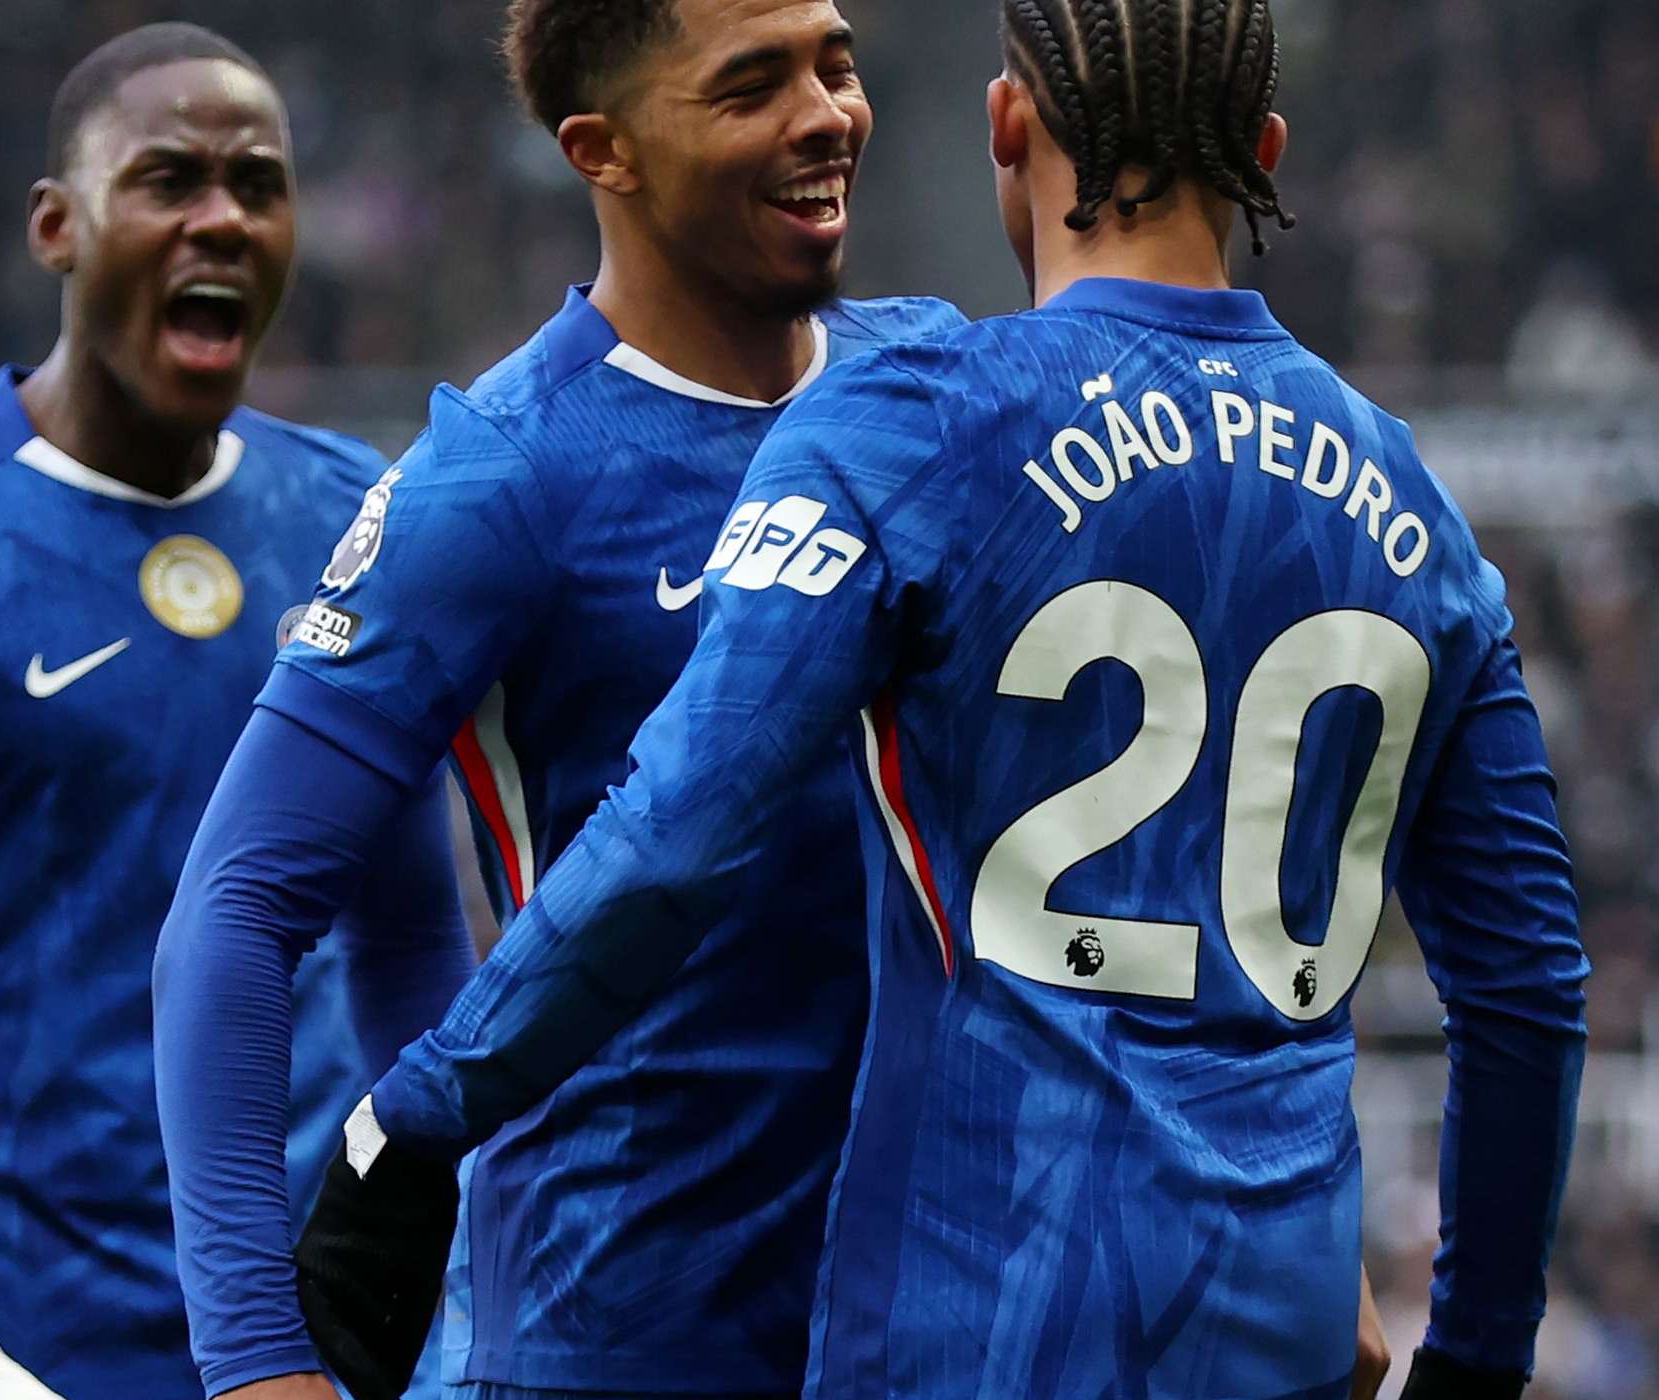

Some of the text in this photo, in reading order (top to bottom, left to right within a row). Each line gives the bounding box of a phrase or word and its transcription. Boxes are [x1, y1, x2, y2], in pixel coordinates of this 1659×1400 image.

[1197, 358, 1238, 377] CFC
[1022, 373, 1194, 534] JOÃO
[1210, 389, 1431, 578] PEDRO
[718, 519, 849, 577] FPT
[970, 577, 1433, 1022] 20
